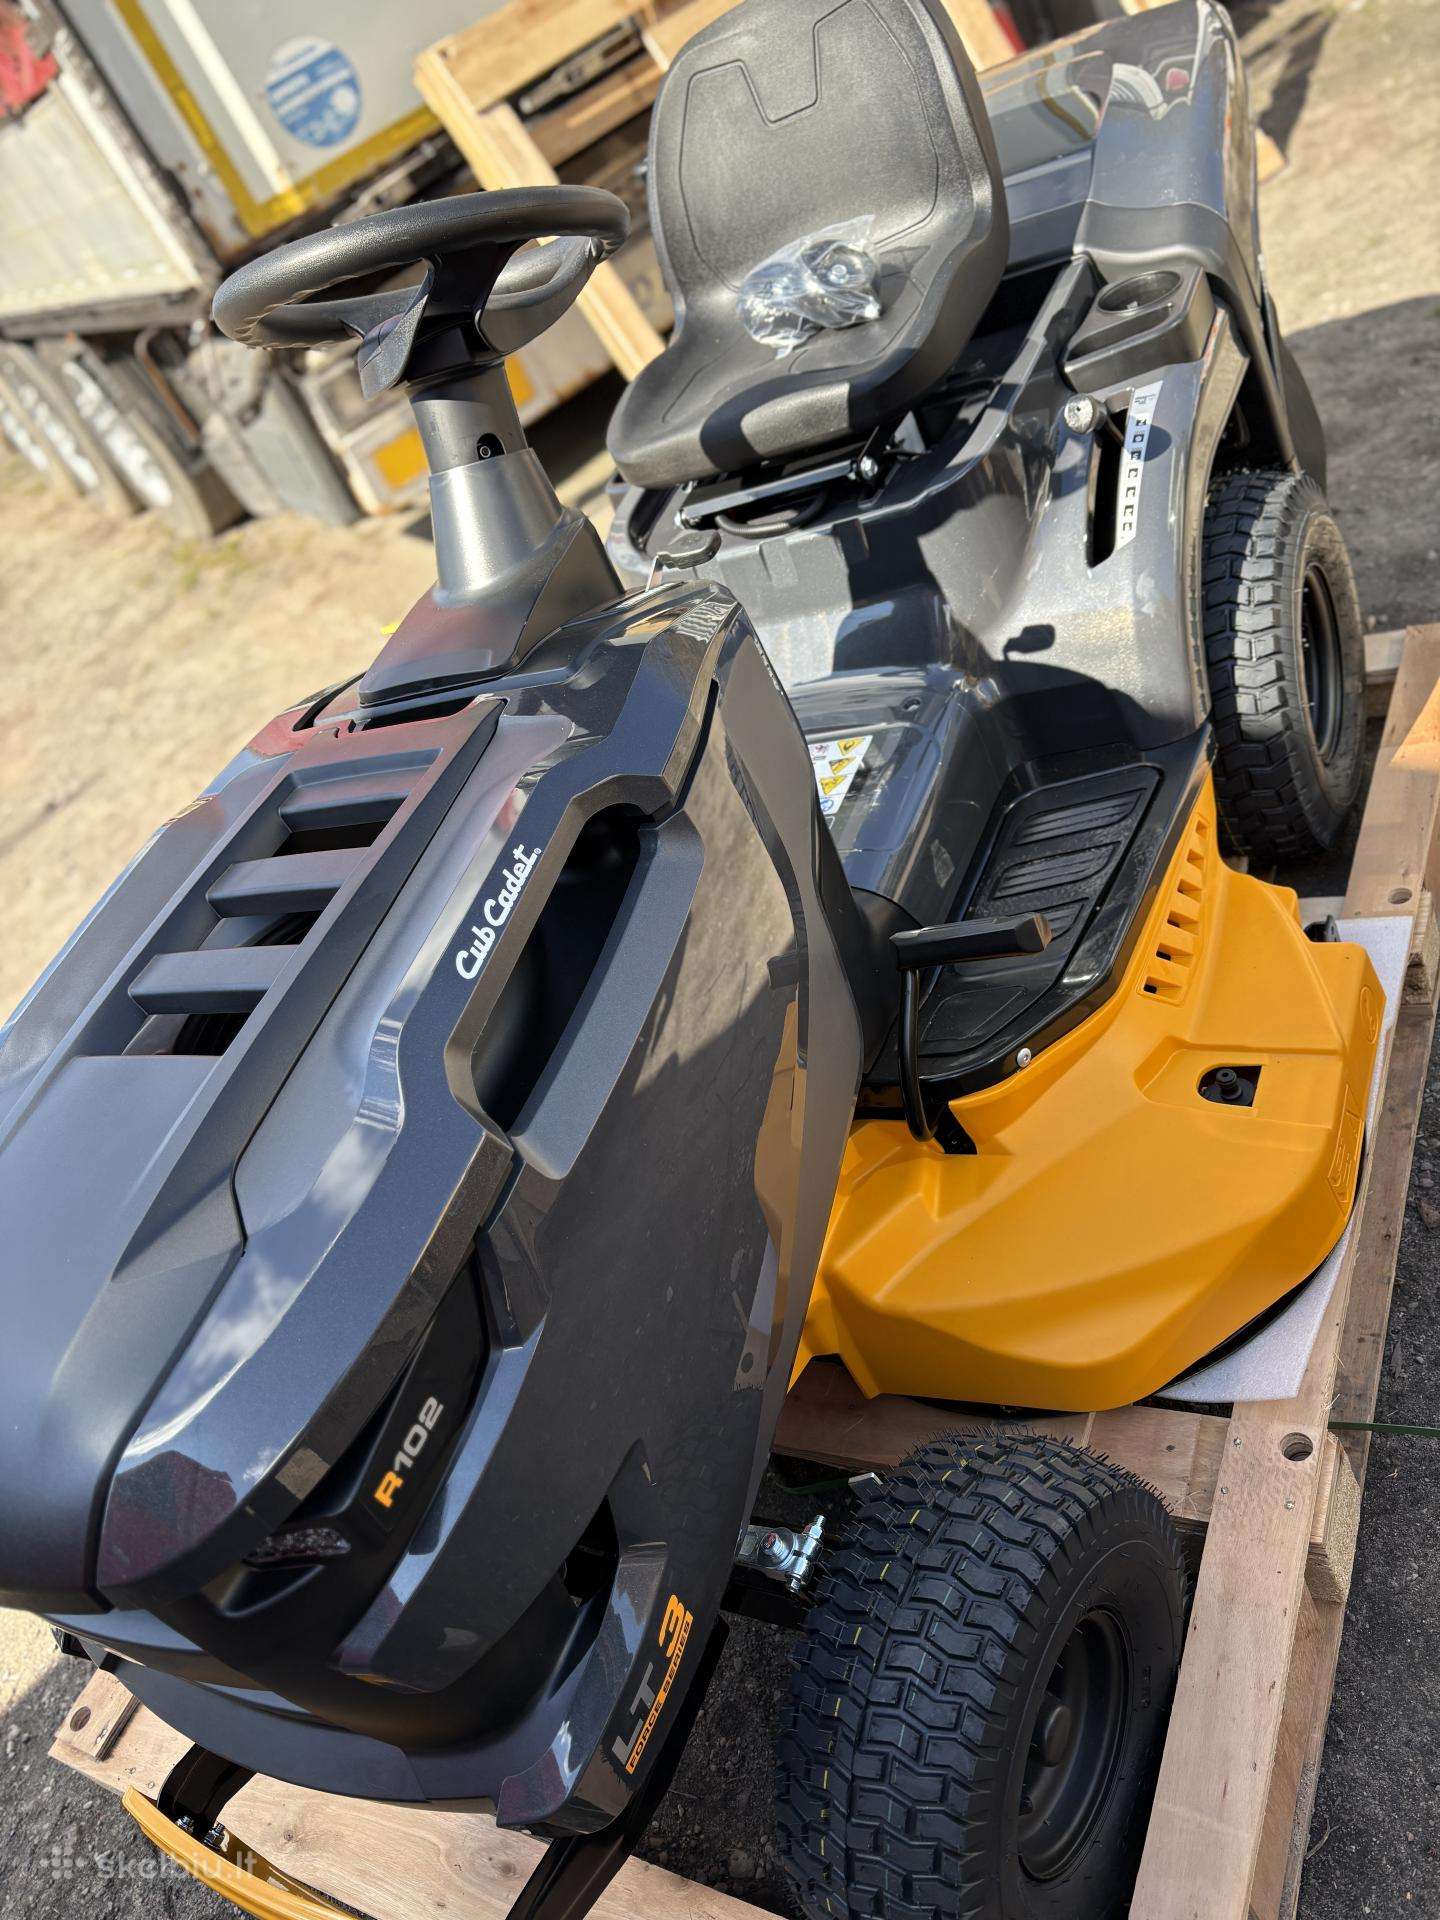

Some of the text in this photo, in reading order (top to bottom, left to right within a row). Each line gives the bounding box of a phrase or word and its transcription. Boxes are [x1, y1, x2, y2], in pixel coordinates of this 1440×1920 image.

[455, 925, 496, 980] Cub
[374, 1396, 444, 1508] R102
[629, 1619, 691, 1770] FORCE SERIES
